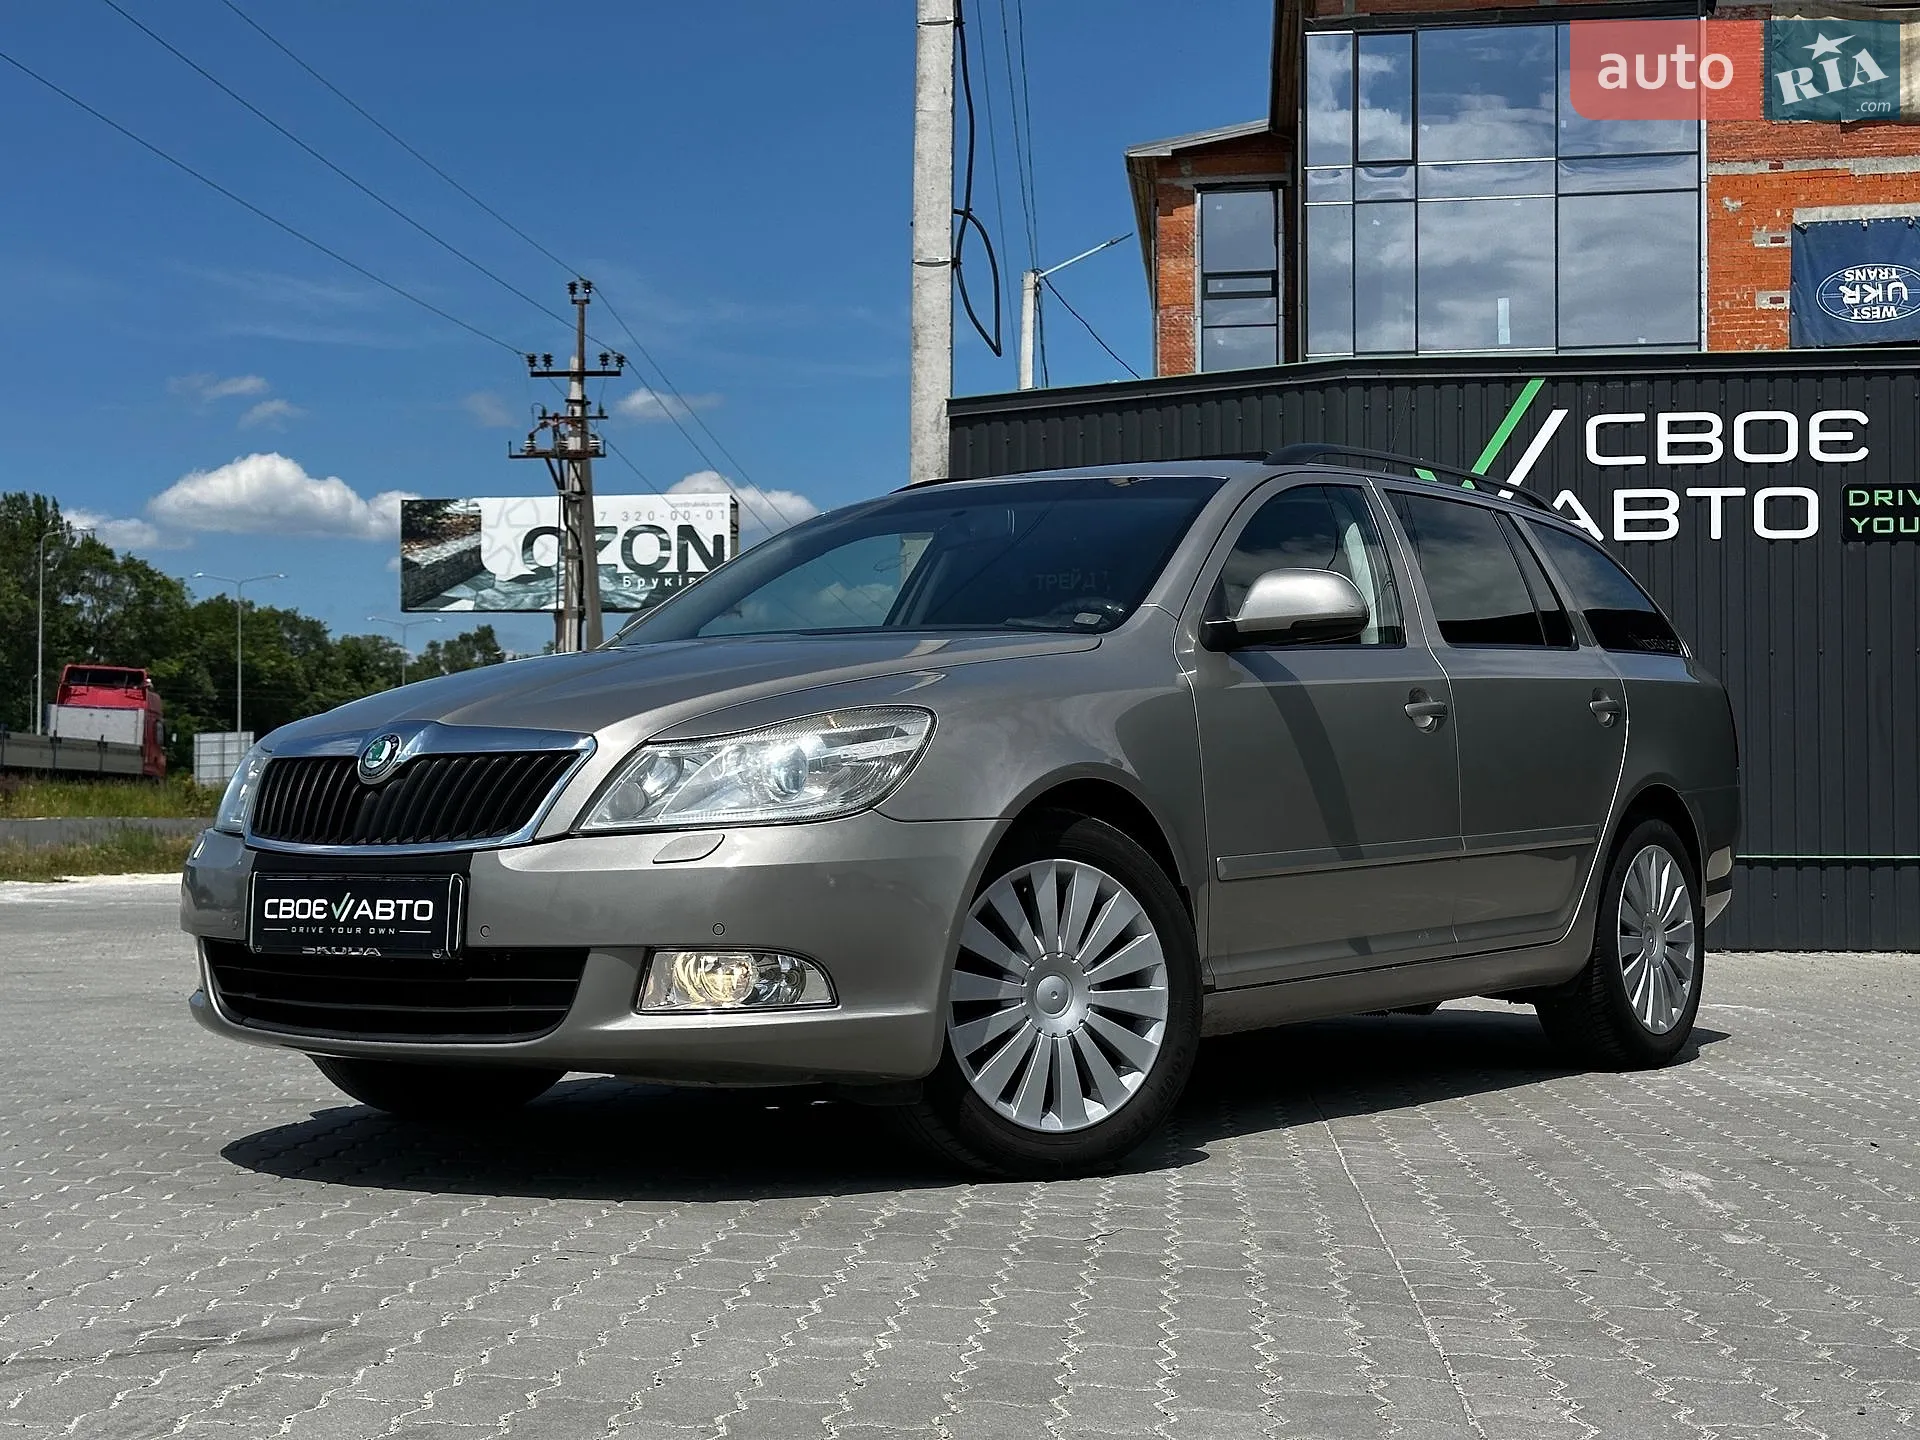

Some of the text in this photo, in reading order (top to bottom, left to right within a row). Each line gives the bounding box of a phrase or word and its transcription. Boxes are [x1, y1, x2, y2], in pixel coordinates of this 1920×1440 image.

[1844, 267, 1900, 282] TRANS
[1838, 281, 1909, 305] UKR
[1850, 305, 1898, 320] WEST
[1585, 409, 1870, 467] СВОЄ
[1552, 486, 1819, 542] АВТО
[264, 898, 434, 921] СВОЄ АВТО
[290, 926, 396, 936] DRIVE YOUR OWN
